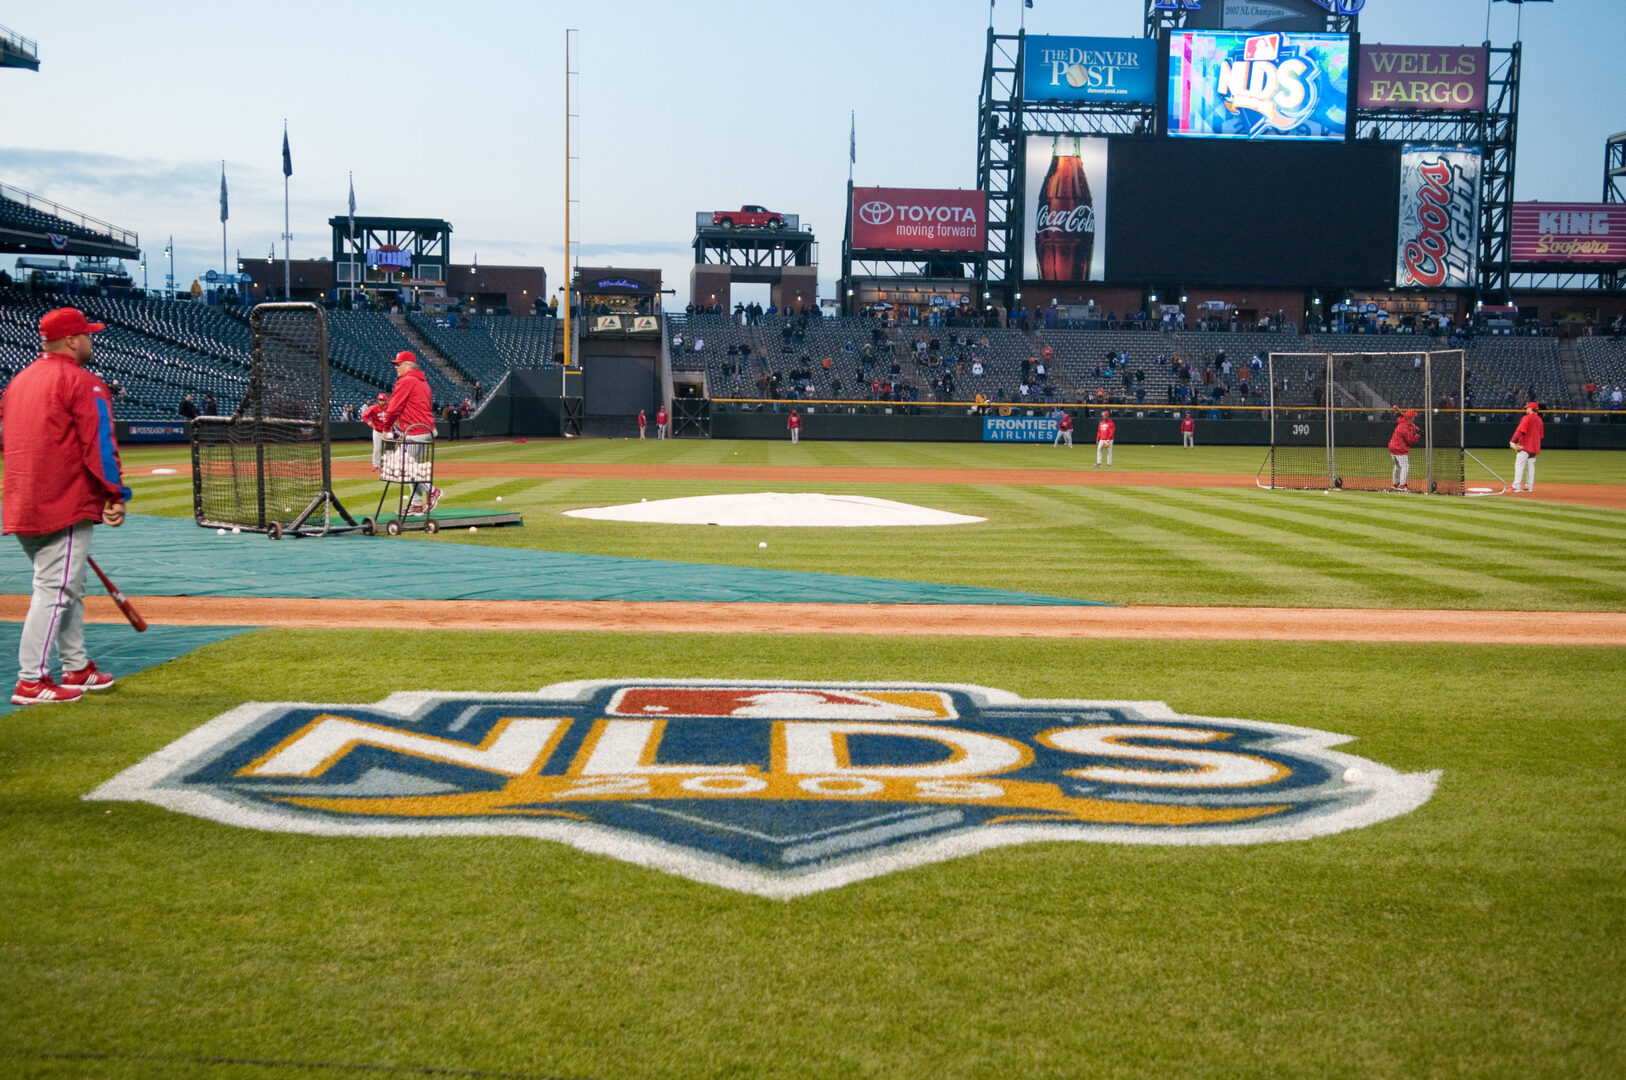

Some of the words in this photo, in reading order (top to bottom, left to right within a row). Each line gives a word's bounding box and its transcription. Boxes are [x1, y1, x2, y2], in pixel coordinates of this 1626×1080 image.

[1041, 49, 1068, 63] THE
[1069, 48, 1139, 66] DENVER
[1368, 52, 1476, 75] WELLS
[1217, 58, 1307, 109] NLDS
[1369, 80, 1474, 103] FARGO
[896, 205, 977, 222] TOYOTA
[1036, 205, 1096, 234] Coca-Cola
[1404, 157, 1452, 287] Coors
[1447, 164, 1475, 284] LIGHT
[1539, 211, 1610, 235] KING
[896, 222, 935, 239] moving
[937, 223, 977, 237] forward
[1536, 234, 1610, 258] Soopers
[987, 419, 1057, 430] FRONTIER
[991, 430, 1053, 440] AIRLINES
[1292, 424, 1310, 436] 390
[233, 711, 1293, 788] NLDS
